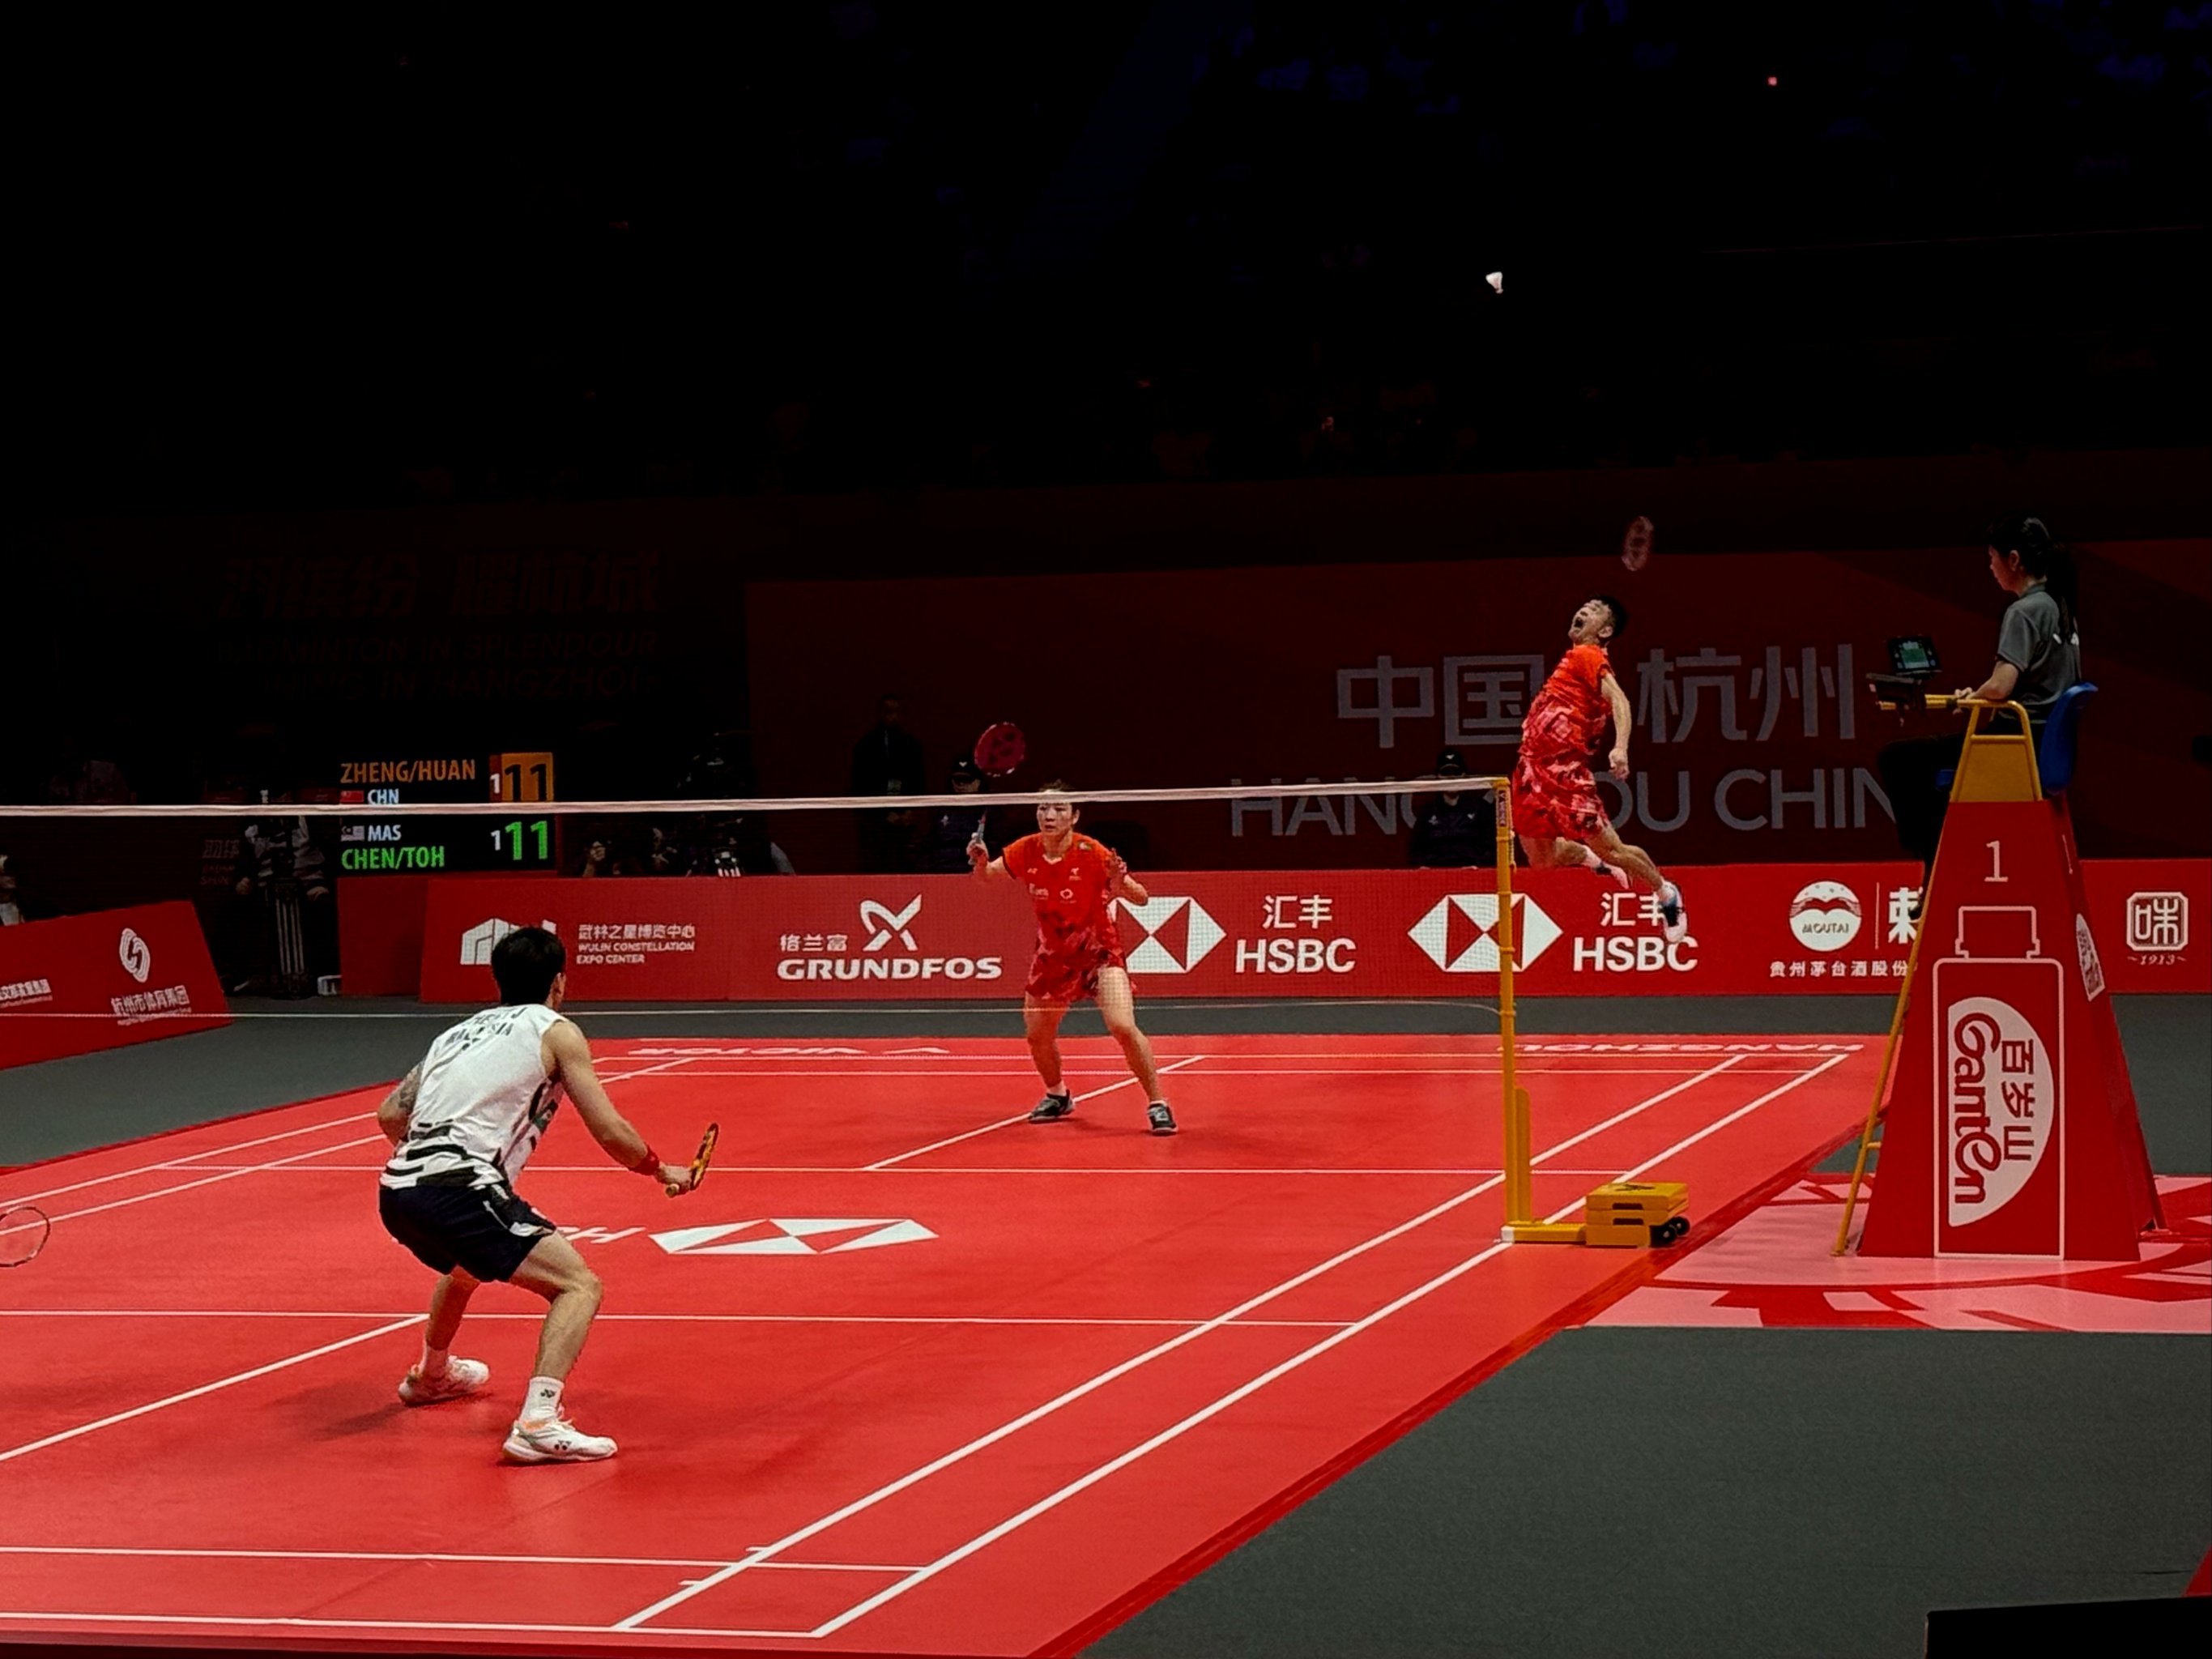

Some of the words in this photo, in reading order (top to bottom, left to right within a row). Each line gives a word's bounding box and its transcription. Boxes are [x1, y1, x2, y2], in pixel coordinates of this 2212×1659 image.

[1336, 655, 1545, 749] 中国
[1636, 643, 1856, 744] 杭州
[340, 758, 476, 784] ZHENG/HUAN
[367, 788, 400, 804] CHN
[1713, 767, 1897, 832] CHIN
[367, 824, 402, 842] MAS
[504, 820, 548, 861] 11
[341, 846, 445, 870] CHEN/TOH
[1984, 840, 2009, 883] 1
[1262, 894, 1333, 929] 汇丰
[1801, 922, 1850, 935] MOUTAI
[613, 940, 696, 952] CONSTELLATION
[779, 933, 848, 953] 格兰富
[1234, 936, 1357, 974] HSBC
[1572, 936, 1699, 973] HSBC
[575, 953, 604, 965] EXPO
[605, 953, 646, 964] CENTER
[777, 956, 1003, 980] GRUNDFOS
[2001, 1038, 2036, 1162] 百岁山
